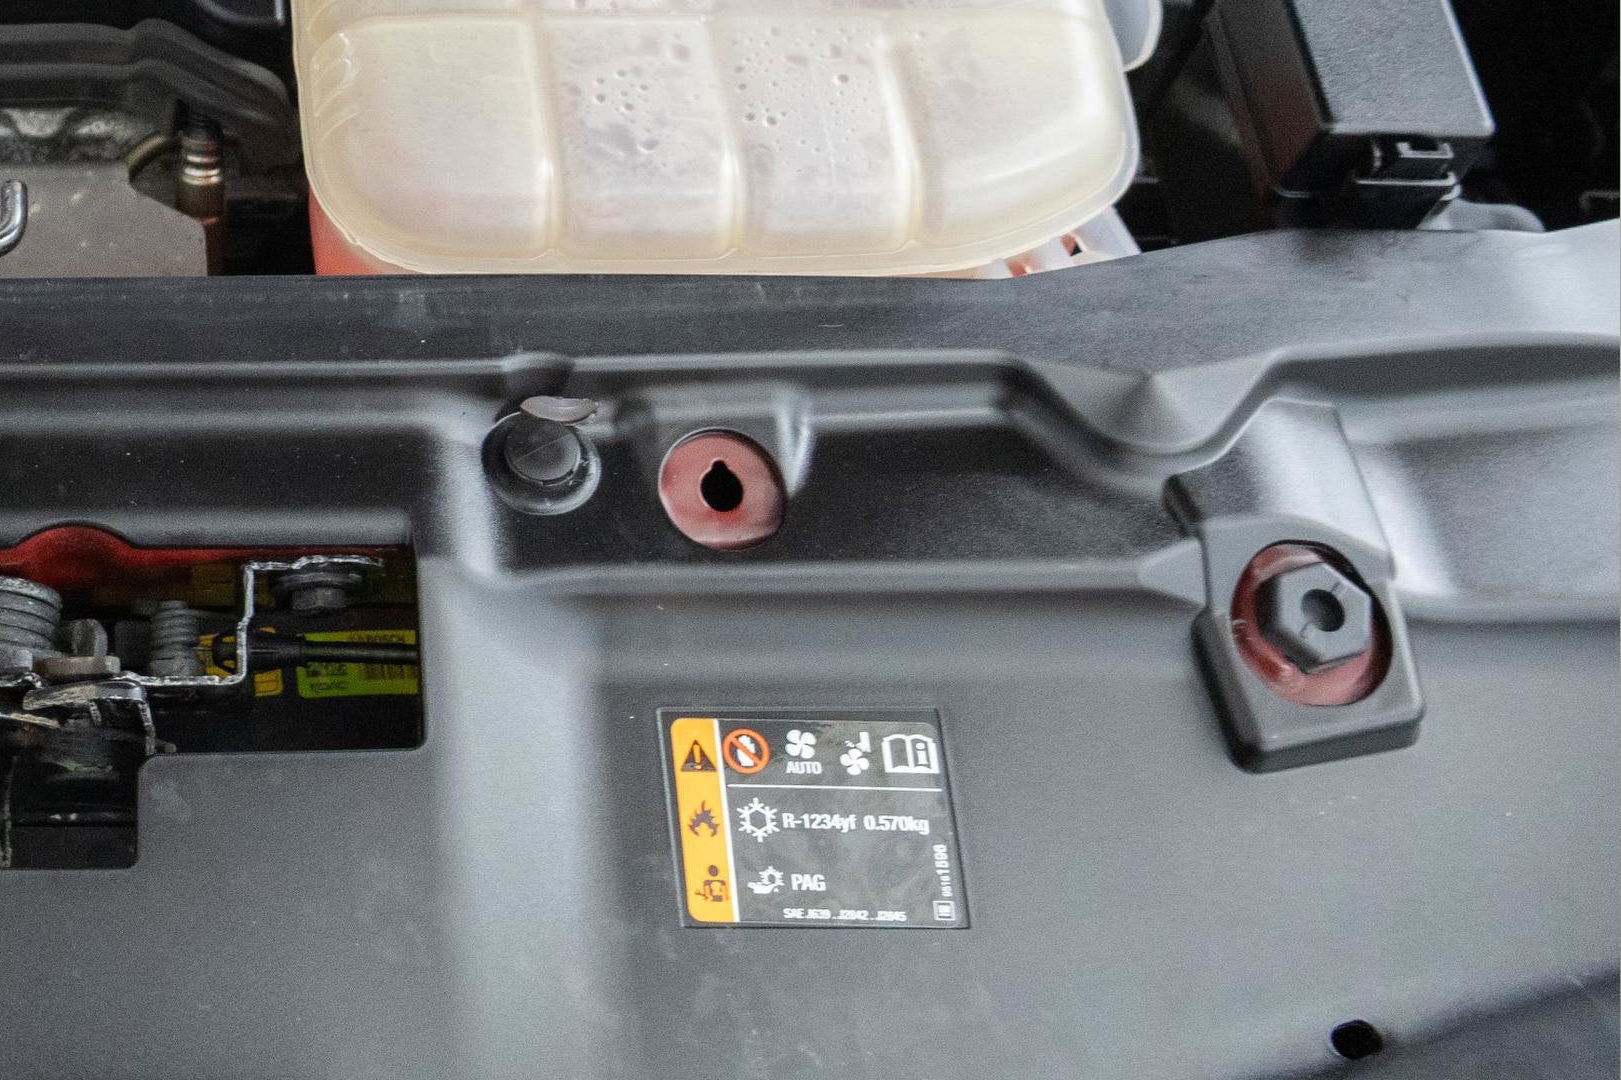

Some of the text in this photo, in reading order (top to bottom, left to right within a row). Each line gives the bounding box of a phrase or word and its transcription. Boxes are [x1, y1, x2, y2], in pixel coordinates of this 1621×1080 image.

[785, 761, 822, 775] AUTO
[782, 812, 930, 835] R-1234yf 0.570kg
[790, 873, 827, 892] PAG
